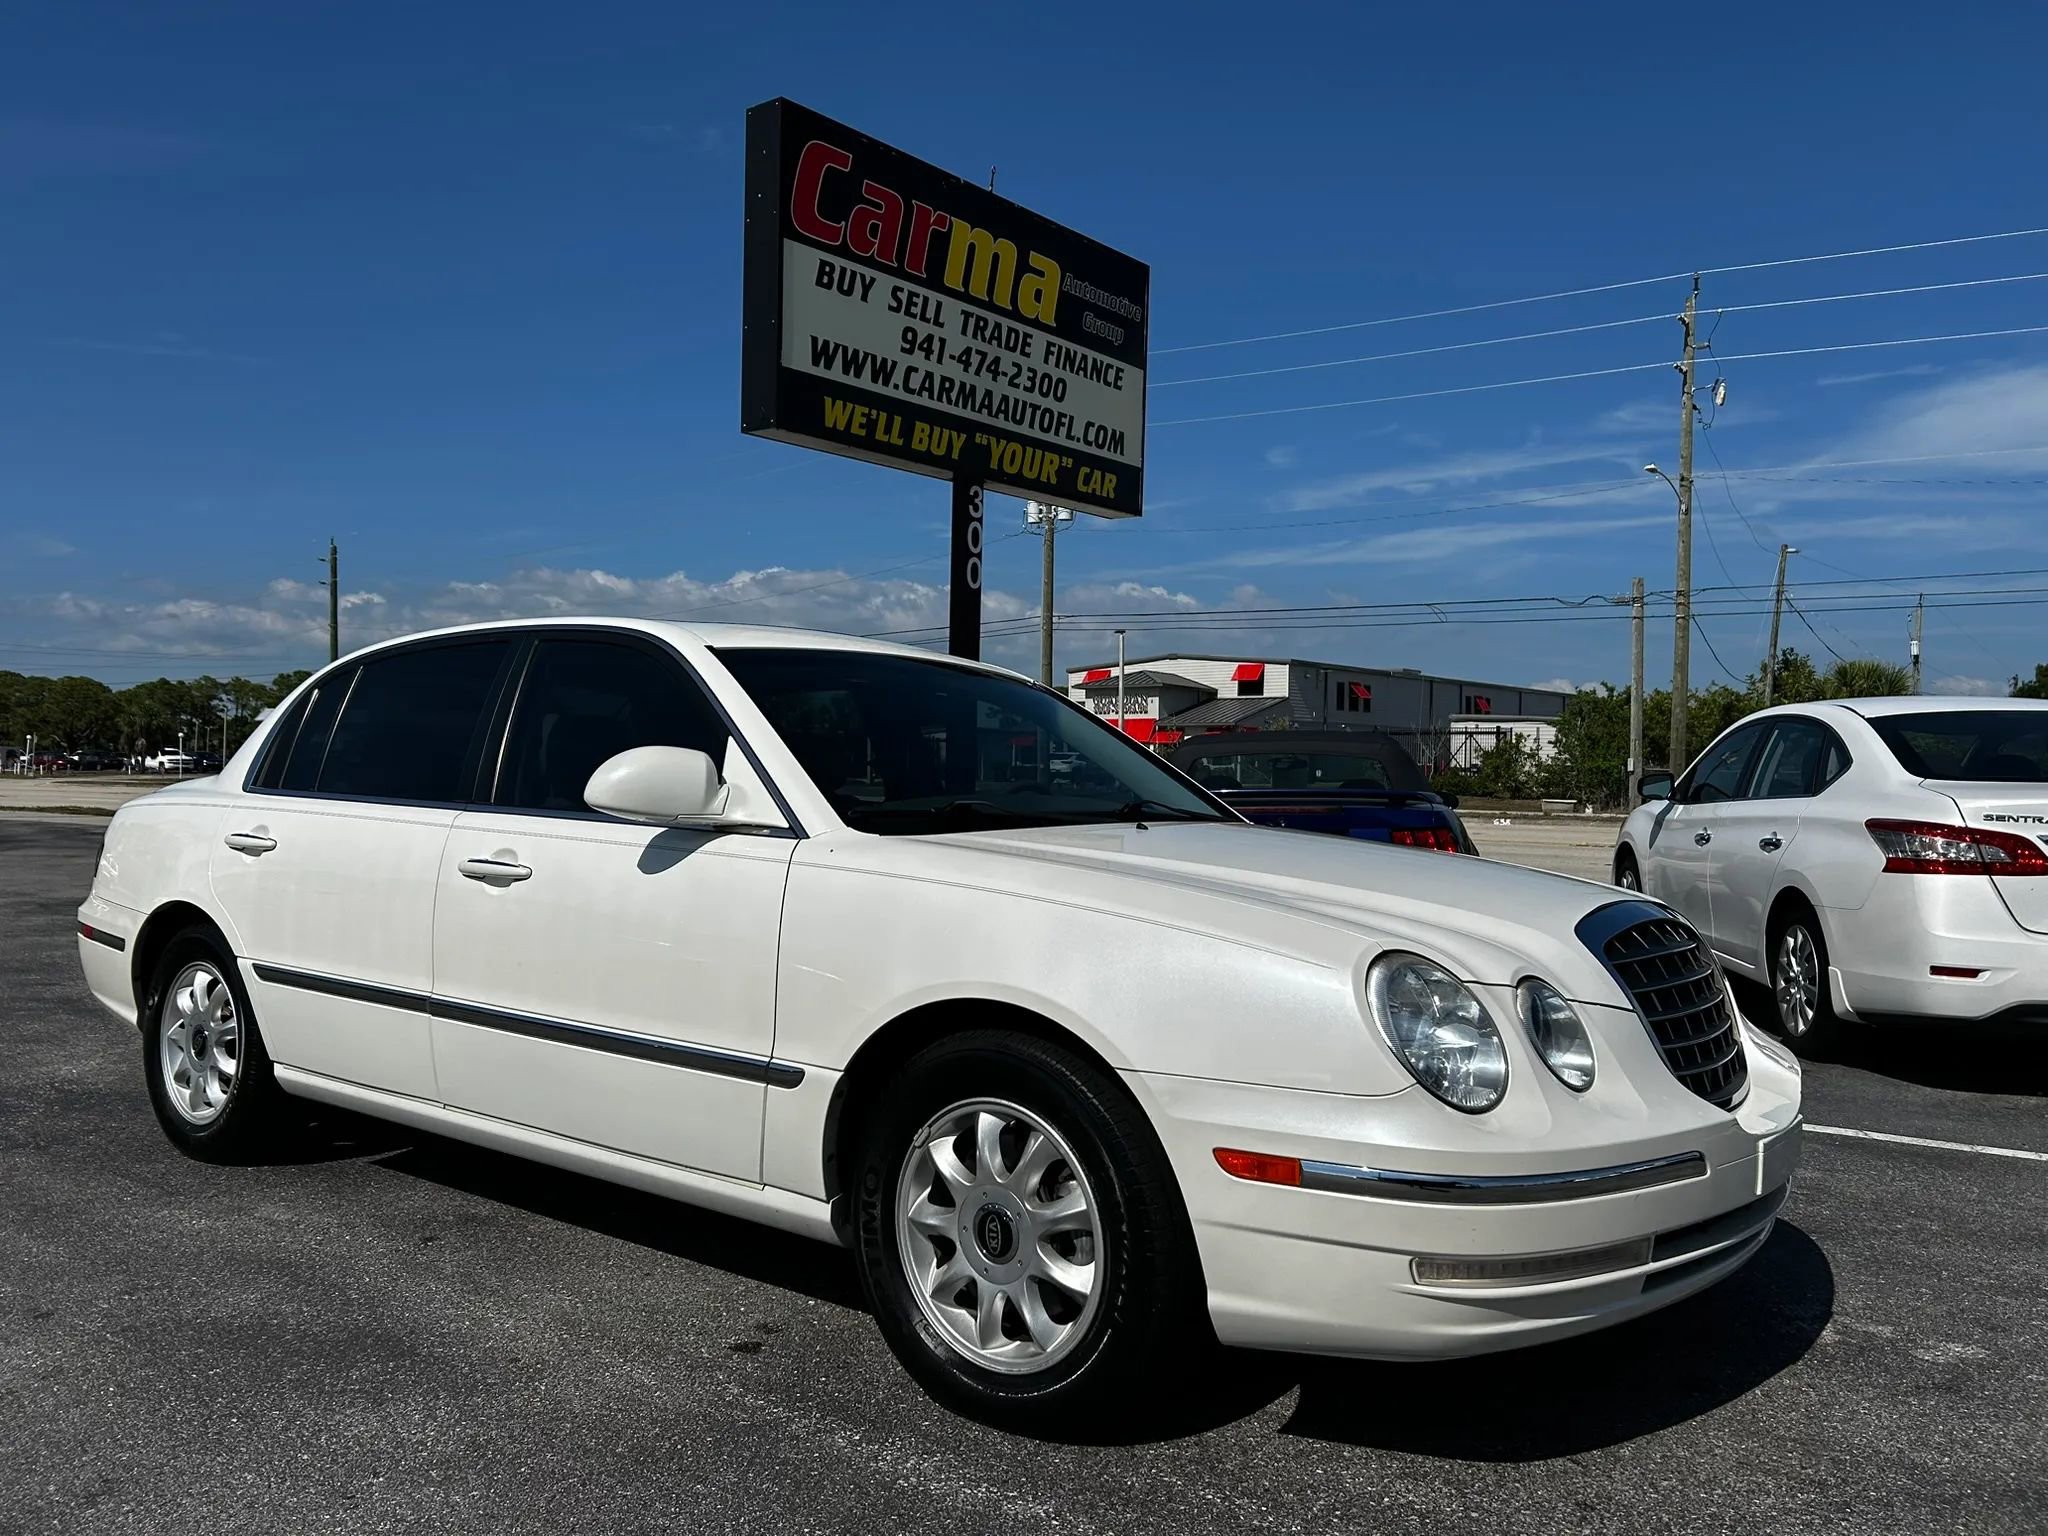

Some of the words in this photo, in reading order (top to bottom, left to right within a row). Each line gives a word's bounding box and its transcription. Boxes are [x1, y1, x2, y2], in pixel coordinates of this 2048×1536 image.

[791, 140, 1062, 326] Carma
[815, 258, 877, 303] BUY
[888, 284, 945, 328] SELL
[960, 309, 1033, 358] TRADE
[1043, 340, 1125, 391] FINANCE
[1063, 273, 1142, 321] Automotive
[1083, 312, 1124, 346] Group
[810, 334, 1125, 456] WWW.CARMAAUTOFL.COM
[901, 326, 1068, 403] 941-474-2300
[824, 396, 904, 446] WE'LL
[912, 421, 966, 460] BUY
[975, 432, 1074, 485] "YOUR"
[1077, 466, 1118, 499] CAR
